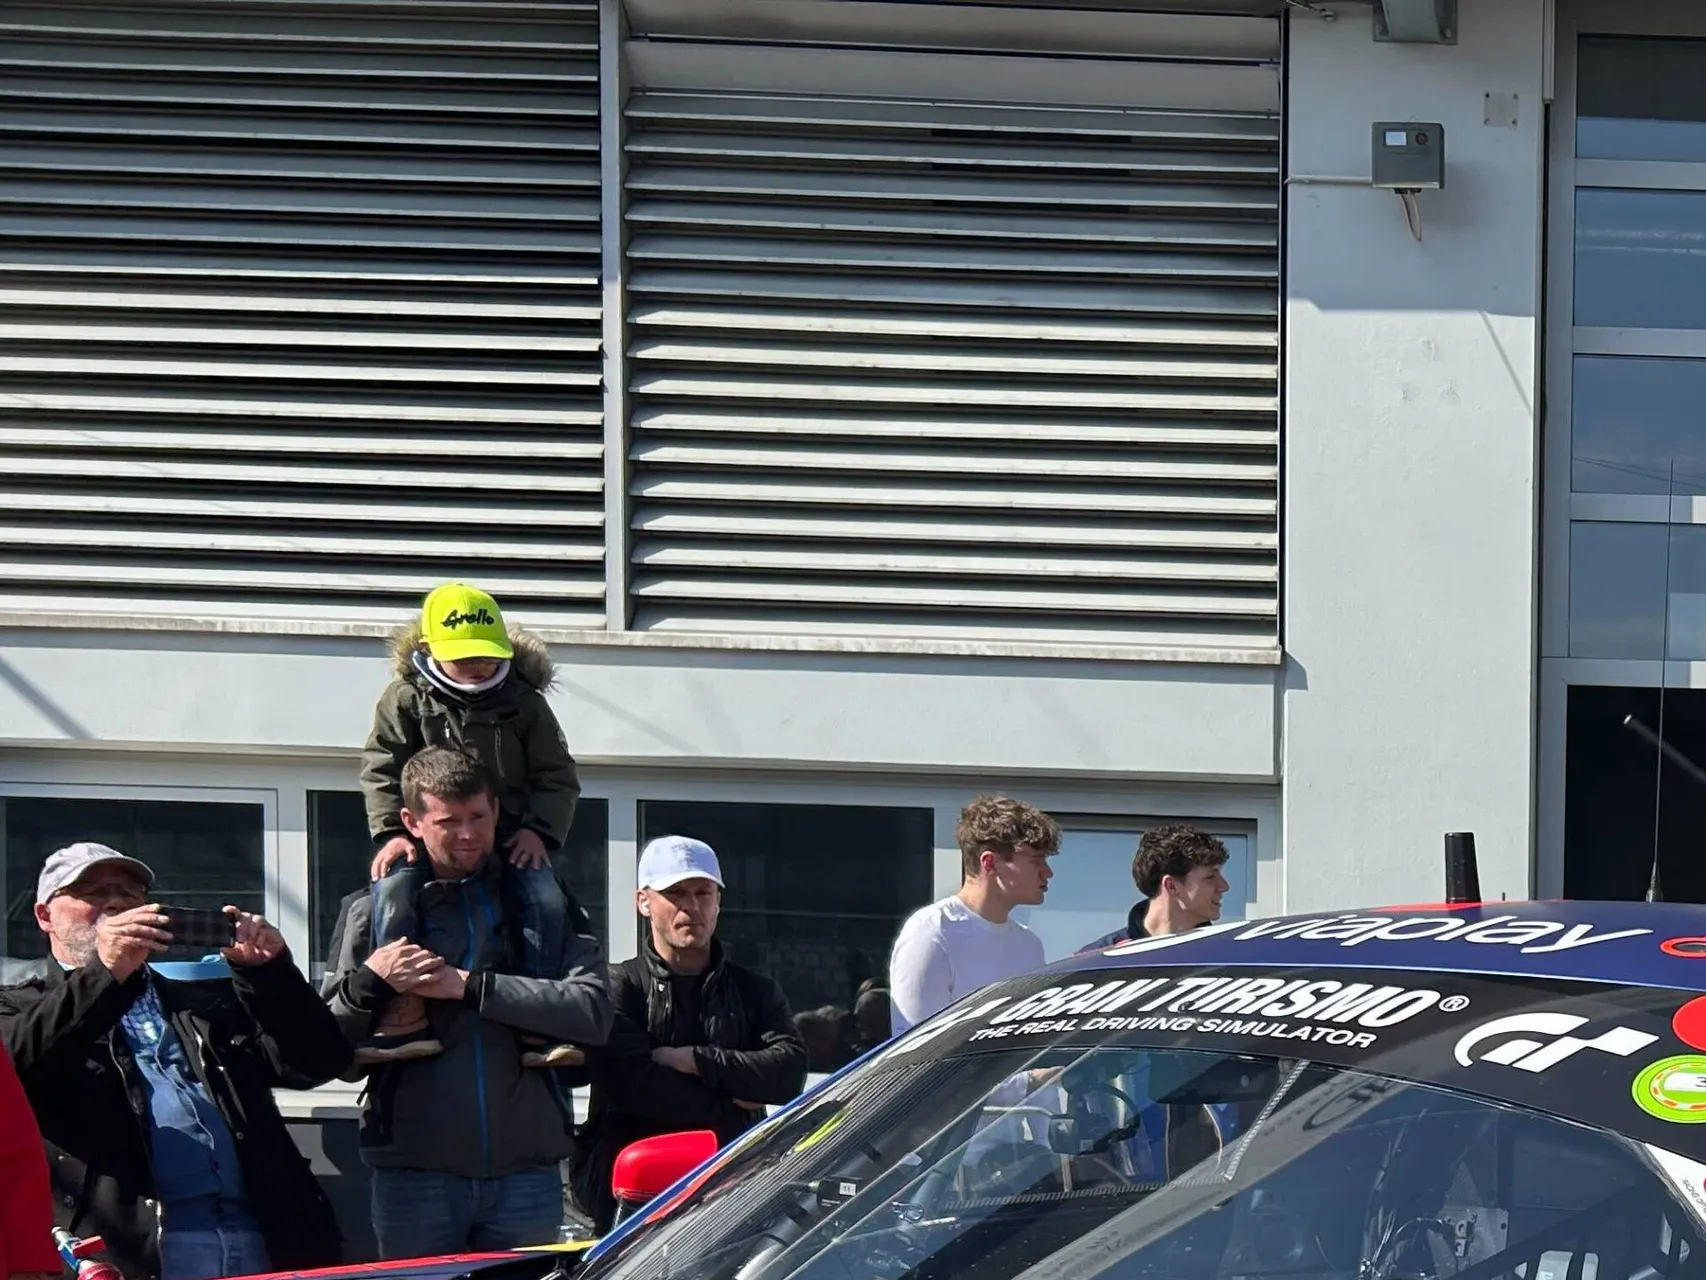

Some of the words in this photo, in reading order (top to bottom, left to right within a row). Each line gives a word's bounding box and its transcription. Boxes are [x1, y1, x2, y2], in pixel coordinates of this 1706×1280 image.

[441, 609, 494, 629] Grello
[1234, 914, 1654, 953] viaplay
[989, 978, 1170, 1025] GRAN
[969, 1026, 1016, 1042] THE
[1012, 1017, 1077, 1035] REAL
[1081, 1016, 1199, 1032] DRIVING
[1198, 1017, 1378, 1049] SIMULATOR
